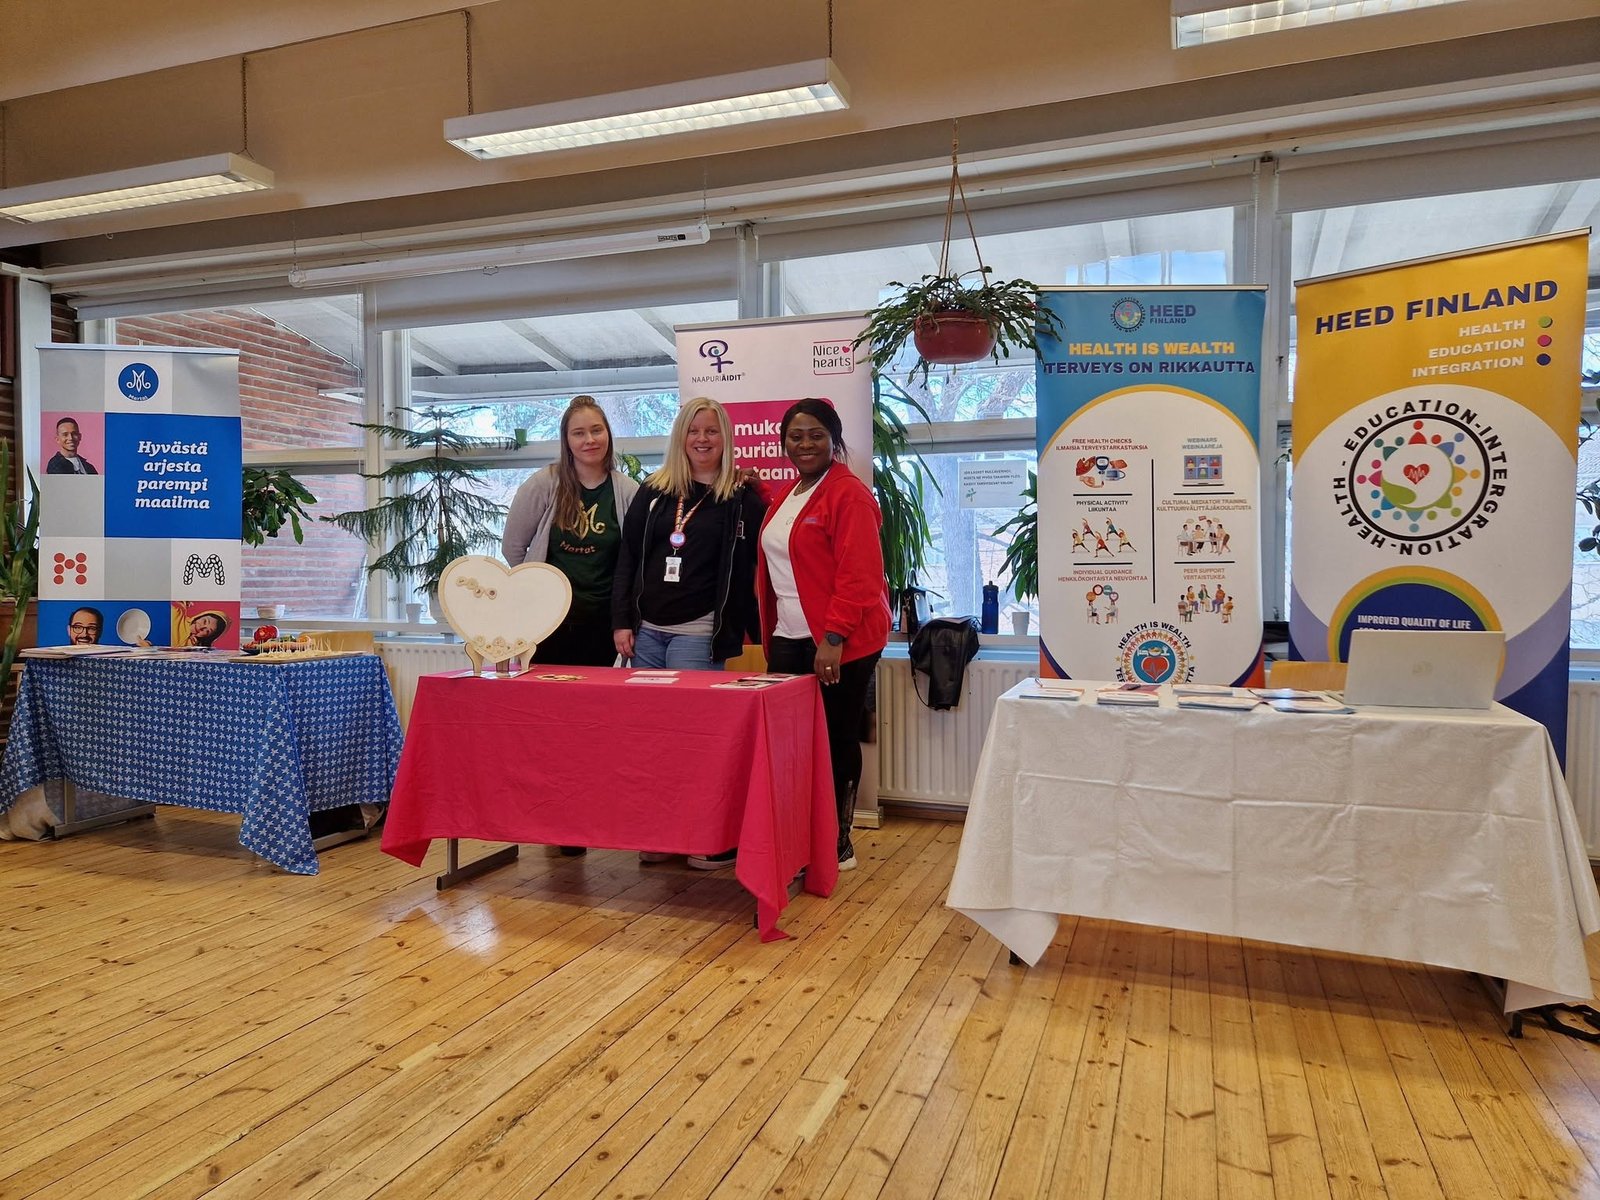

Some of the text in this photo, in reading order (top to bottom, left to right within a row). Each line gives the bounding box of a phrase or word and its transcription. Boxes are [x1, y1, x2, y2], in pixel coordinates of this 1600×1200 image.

[1150, 304, 1196, 317] HEED
[1315, 280, 1558, 335] HEED FINLAND
[1459, 319, 1526, 337] HEALTH
[813, 345, 839, 356] Nice
[1069, 342, 1235, 355] HEALTH IS WEALTH
[1428, 337, 1525, 359] EDUCATION
[813, 356, 851, 368] hearts
[1045, 361, 1255, 374] TERVEYS ON RIKKAUTTA
[1412, 356, 1524, 378] INTEGRATION
[137, 441, 208, 457] Hyvästä
[143, 460, 202, 475] arjesta
[137, 477, 208, 493] parempi
[135, 495, 210, 509] maailma
[1357, 615, 1471, 629] IMPROVED QUALITY OF LIFE
[1118, 622, 1147, 649] HEALTH
[1161, 622, 1192, 649] WEALTH
